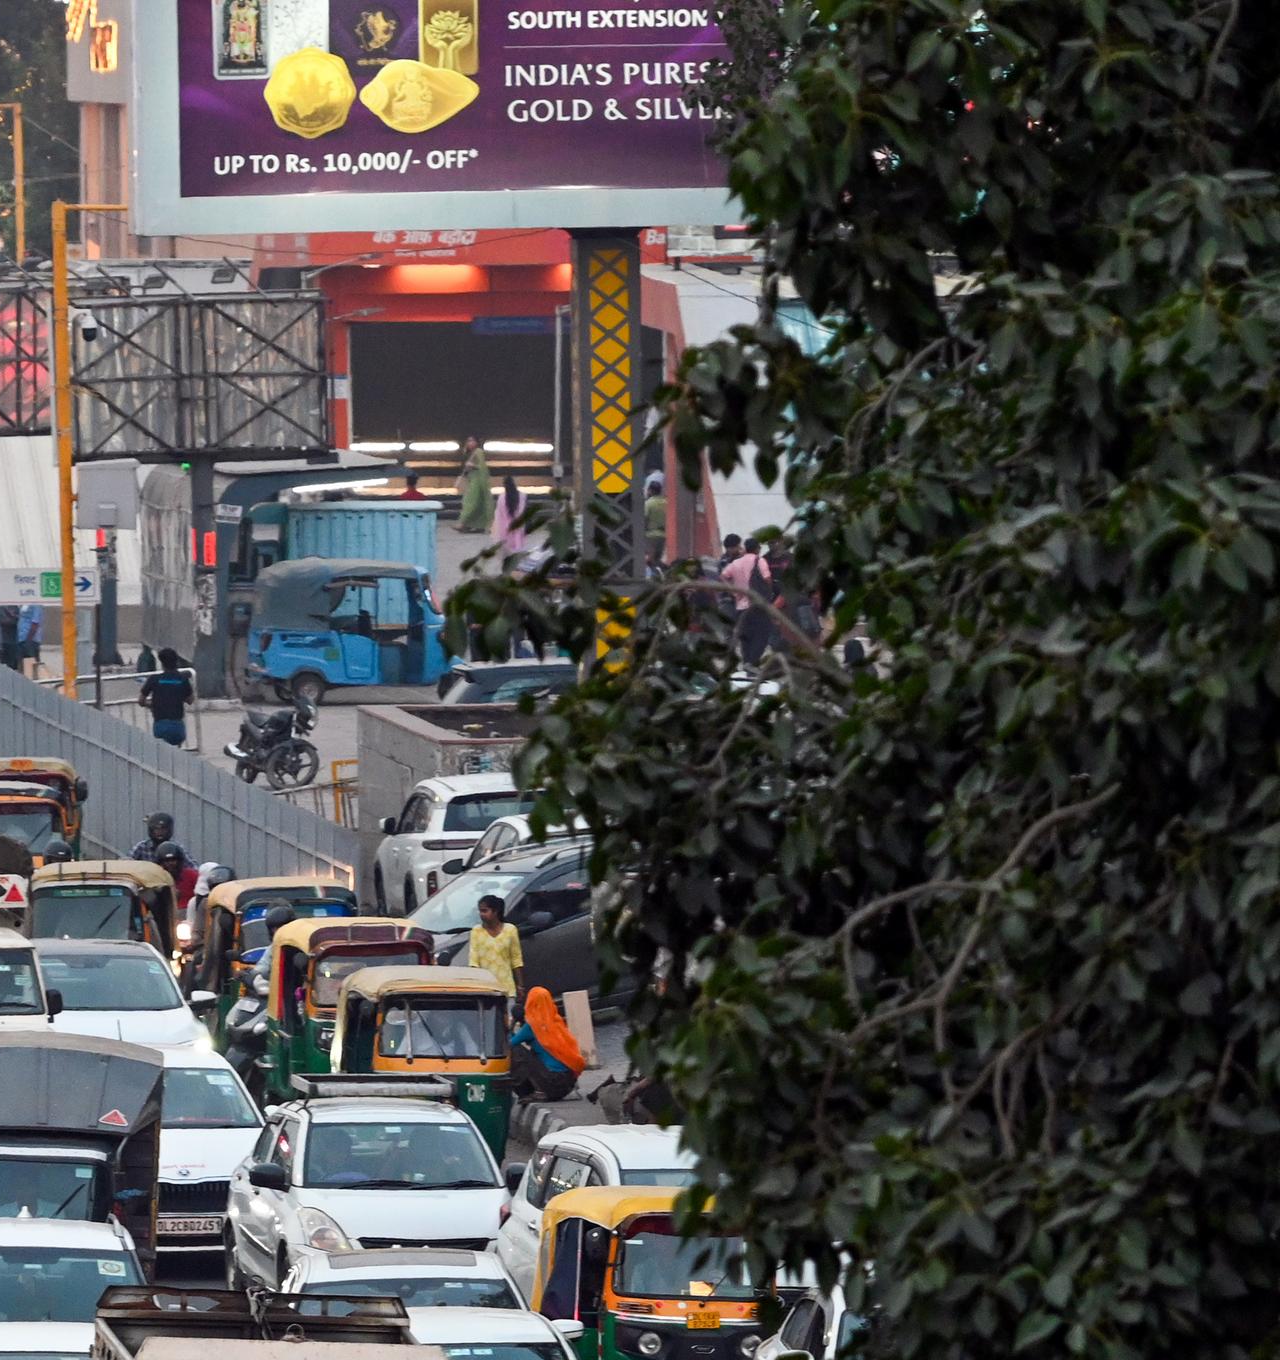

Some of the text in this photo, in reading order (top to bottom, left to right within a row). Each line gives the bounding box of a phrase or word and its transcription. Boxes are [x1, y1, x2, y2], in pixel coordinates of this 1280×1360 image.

[507, 9, 708, 30] SOUTH EXTENSION
[505, 62, 732, 87] INDIA'S PURES
[517, 99, 594, 123] GOLD
[603, 98, 628, 121] &
[214, 156, 246, 175] UP
[249, 155, 281, 174] TO
[285, 154, 318, 173] Rs.
[323, 150, 421, 174] 10,000/-
